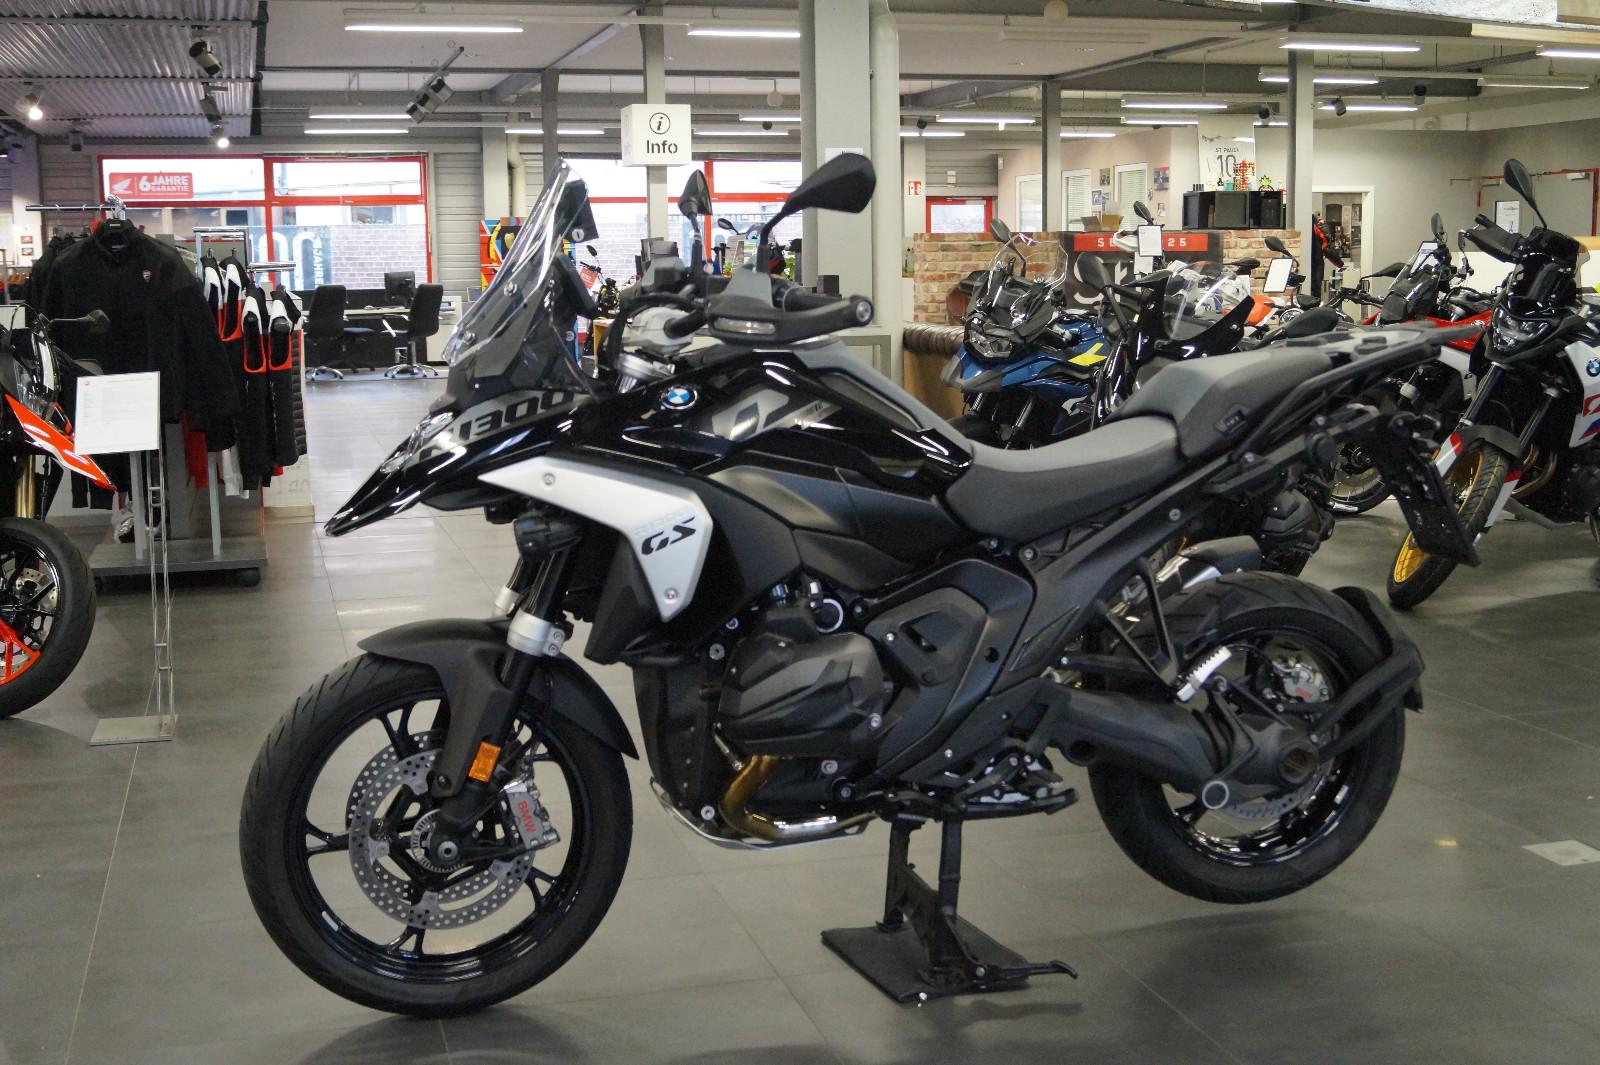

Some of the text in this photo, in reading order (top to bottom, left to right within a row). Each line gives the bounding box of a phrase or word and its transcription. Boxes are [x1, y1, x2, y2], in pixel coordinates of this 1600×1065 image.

[646, 139, 678, 154] Info
[138, 175, 190, 192] 6 JAHRE
[641, 516, 696, 555] GS
[517, 800, 537, 833] BMW
